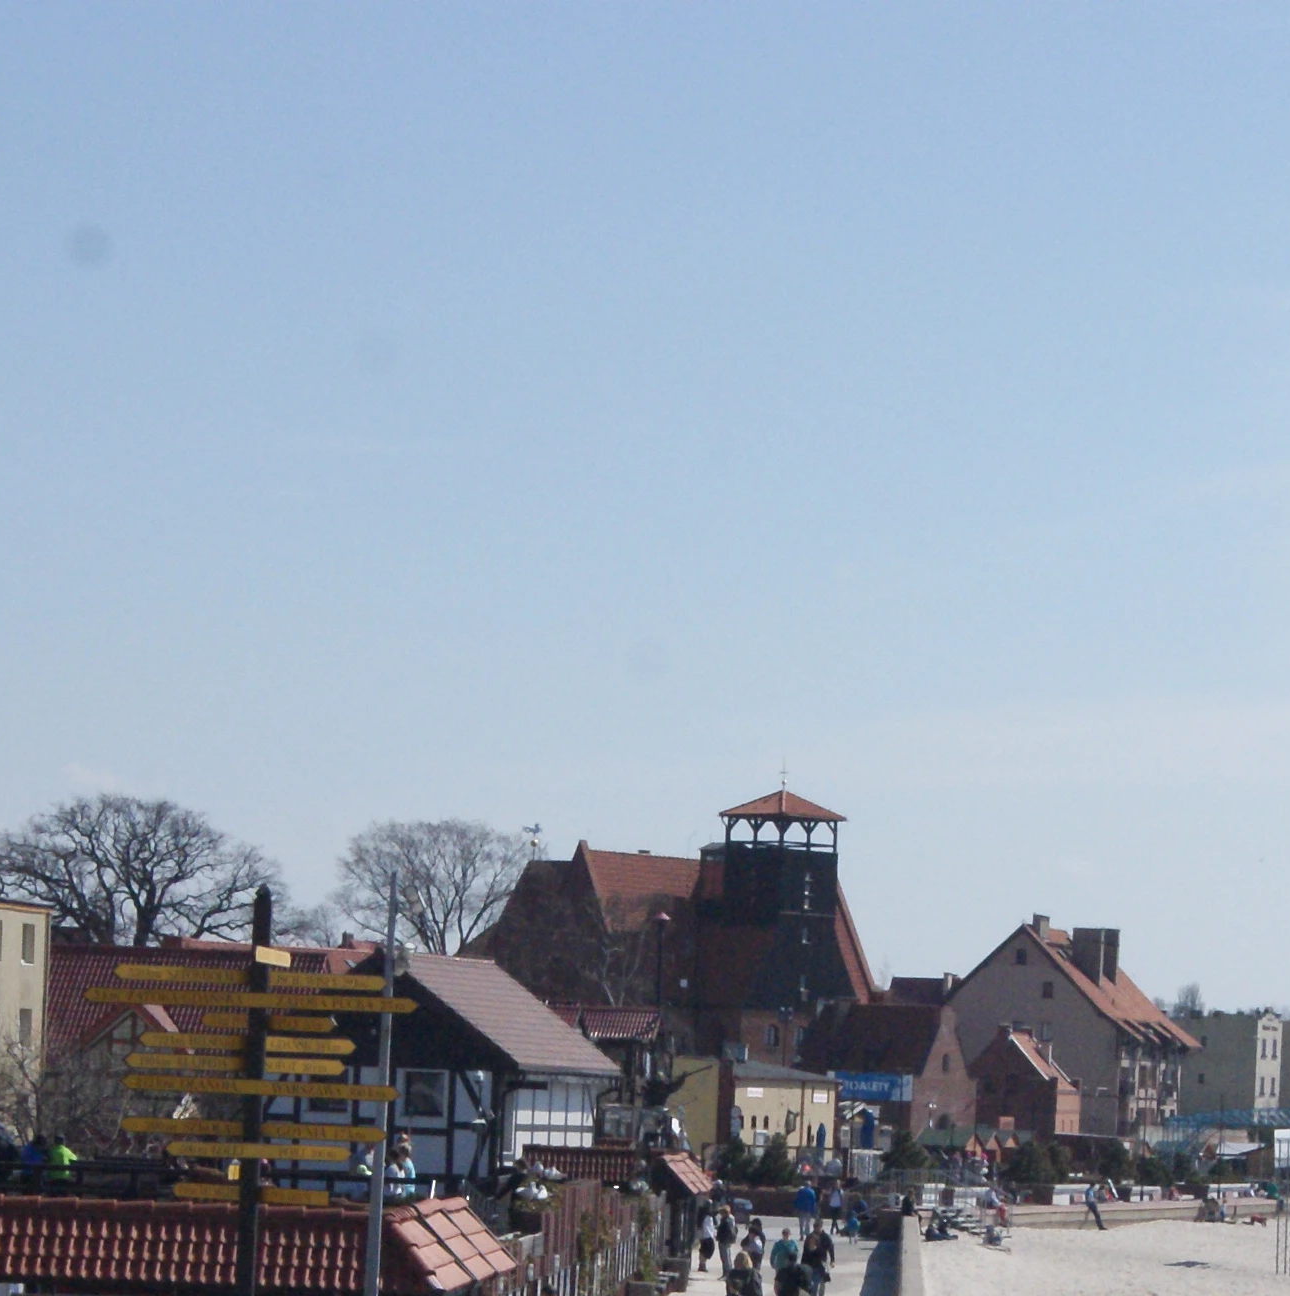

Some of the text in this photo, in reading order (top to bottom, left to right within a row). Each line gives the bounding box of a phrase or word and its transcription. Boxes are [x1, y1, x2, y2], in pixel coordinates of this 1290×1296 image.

[271, 1082, 342, 1097] WARSZAWA
[843, 1080, 890, 1092] TOALETY
[276, 1124, 326, 1138] GDYNIA
